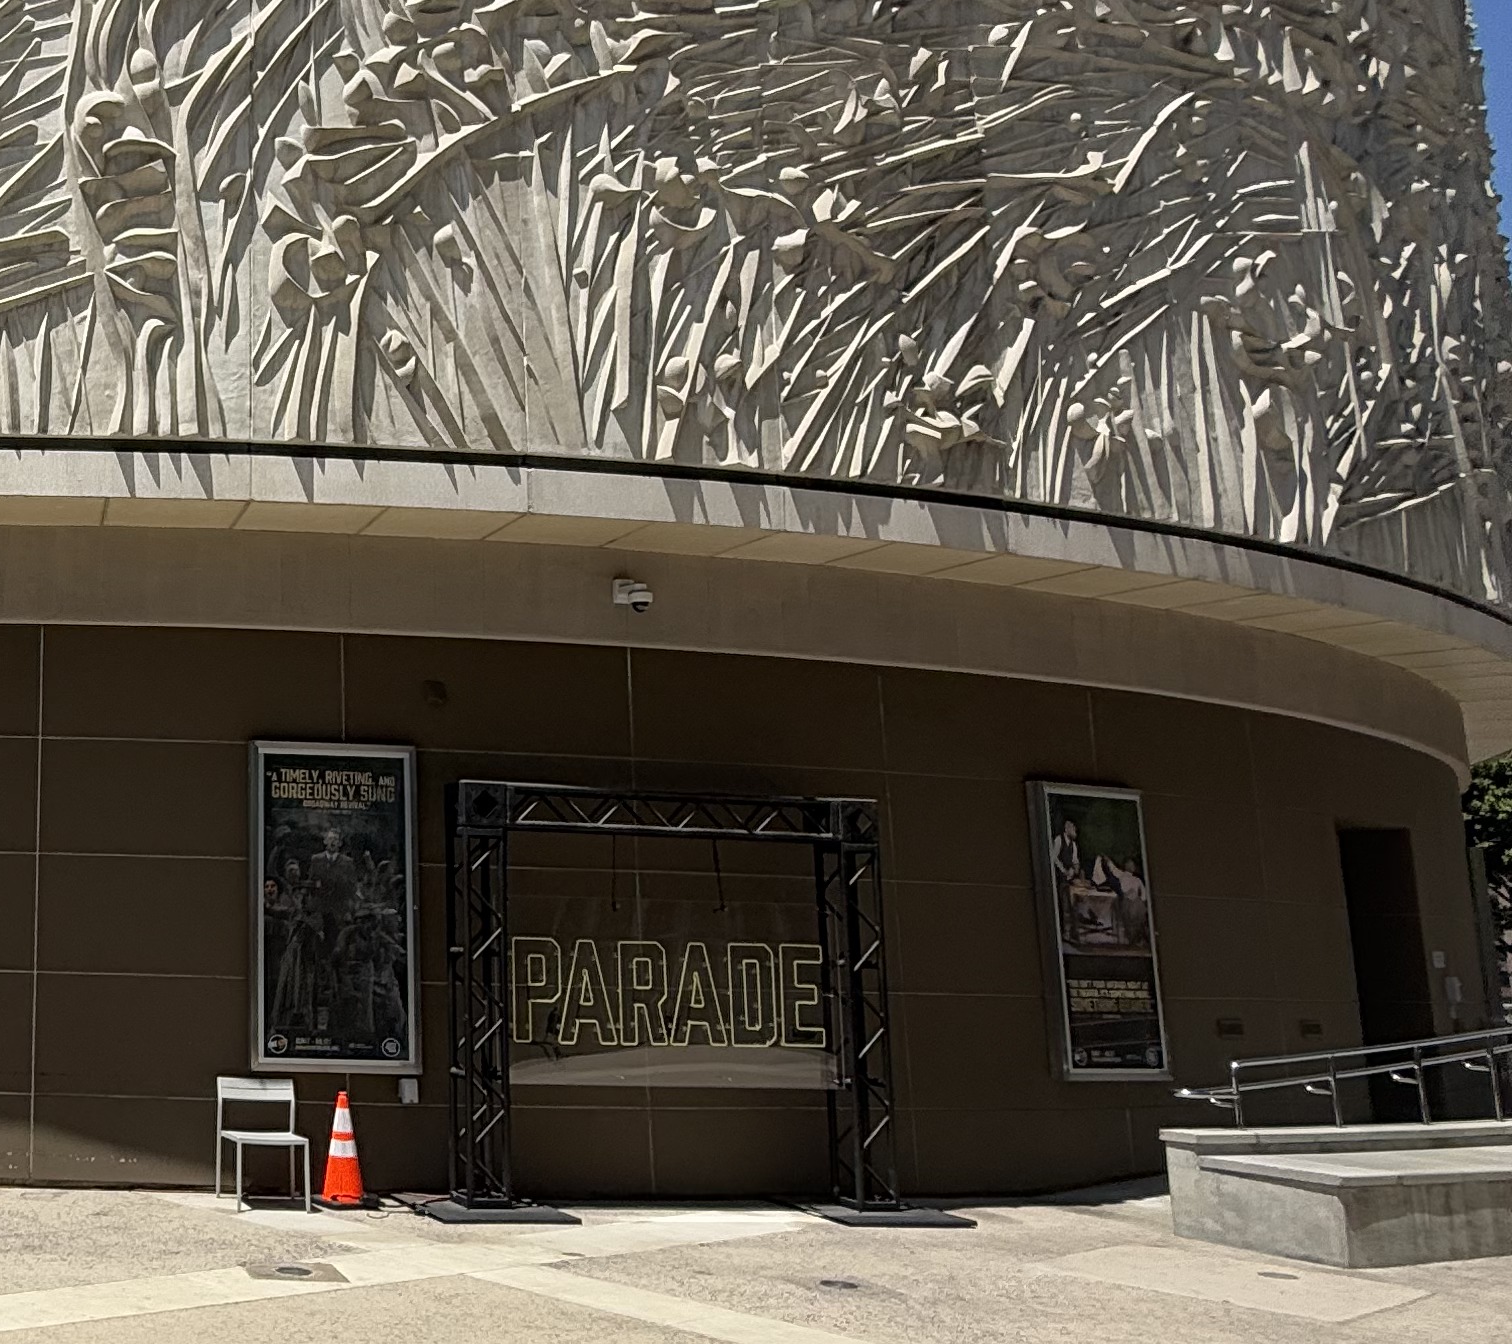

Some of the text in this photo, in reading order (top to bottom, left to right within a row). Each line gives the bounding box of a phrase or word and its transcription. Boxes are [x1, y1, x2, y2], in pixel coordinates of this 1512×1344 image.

[280, 769, 322, 784] TIMELY,
[378, 776, 395, 786] AND
[271, 782, 395, 803] GORGEOUSLY SUNG
[512, 937, 826, 1048] PARADE
